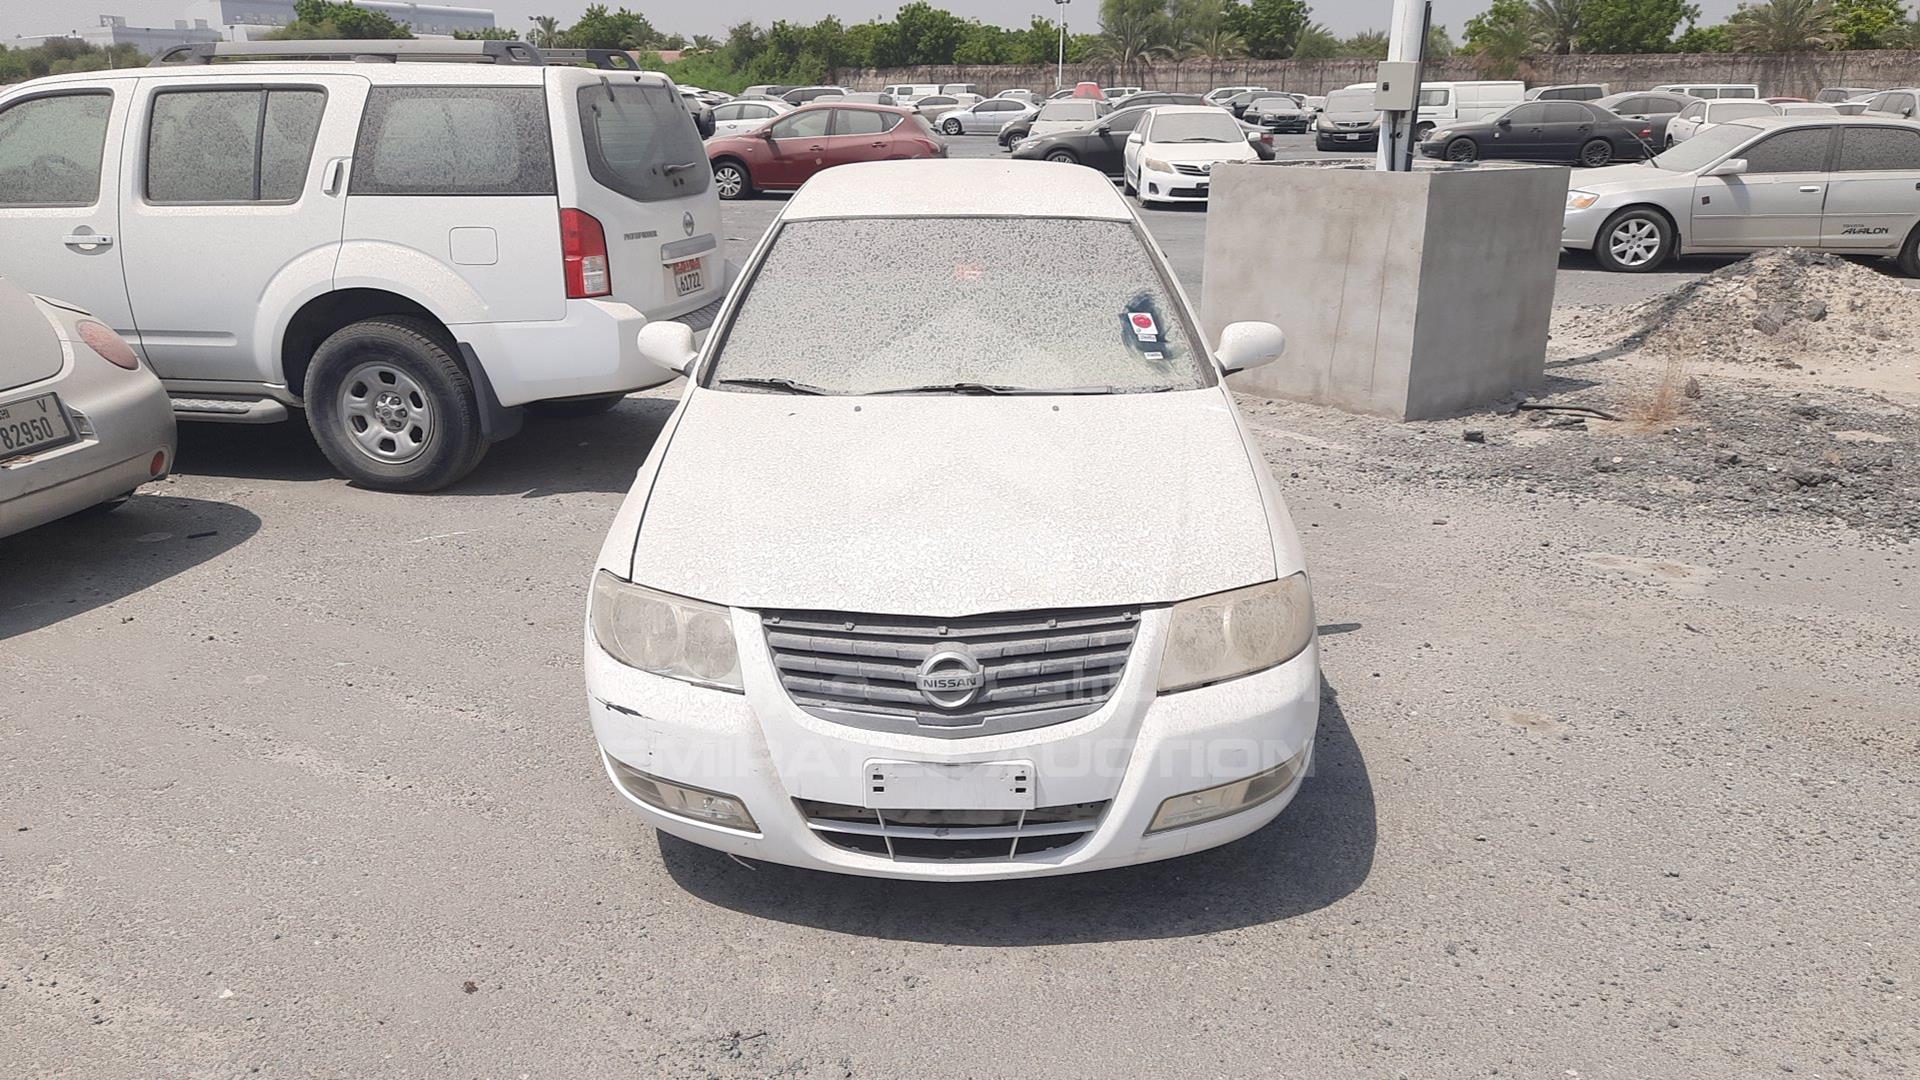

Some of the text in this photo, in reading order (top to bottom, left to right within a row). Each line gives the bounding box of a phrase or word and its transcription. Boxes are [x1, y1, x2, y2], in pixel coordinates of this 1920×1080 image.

[1840, 227, 1889, 235] AVALON
[36, 398, 47, 413] V
[0, 416, 54, 450] 82950
[923, 677, 977, 688] NISSAN
